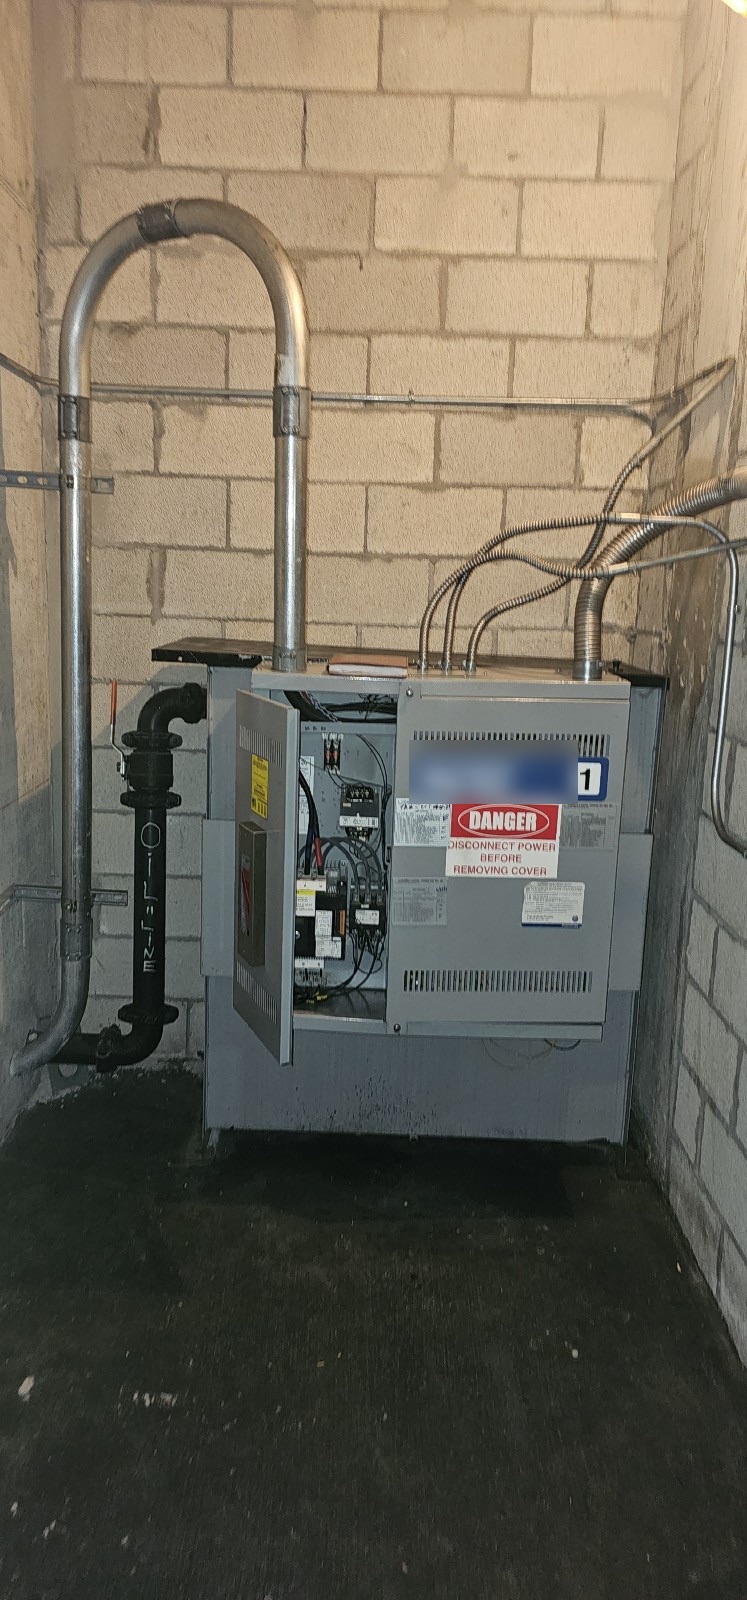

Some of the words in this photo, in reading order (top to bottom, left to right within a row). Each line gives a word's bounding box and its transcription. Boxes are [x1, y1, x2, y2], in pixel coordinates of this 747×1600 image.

[580, 768, 591, 790] 1
[469, 810, 537, 832] DANGER
[448, 840, 516, 852] DISCONNECT
[517, 841, 556, 853] POWER
[480, 853, 522, 864] BEFORE
[453, 864, 508, 876] REMOVING
[511, 866, 547, 877] COVER
